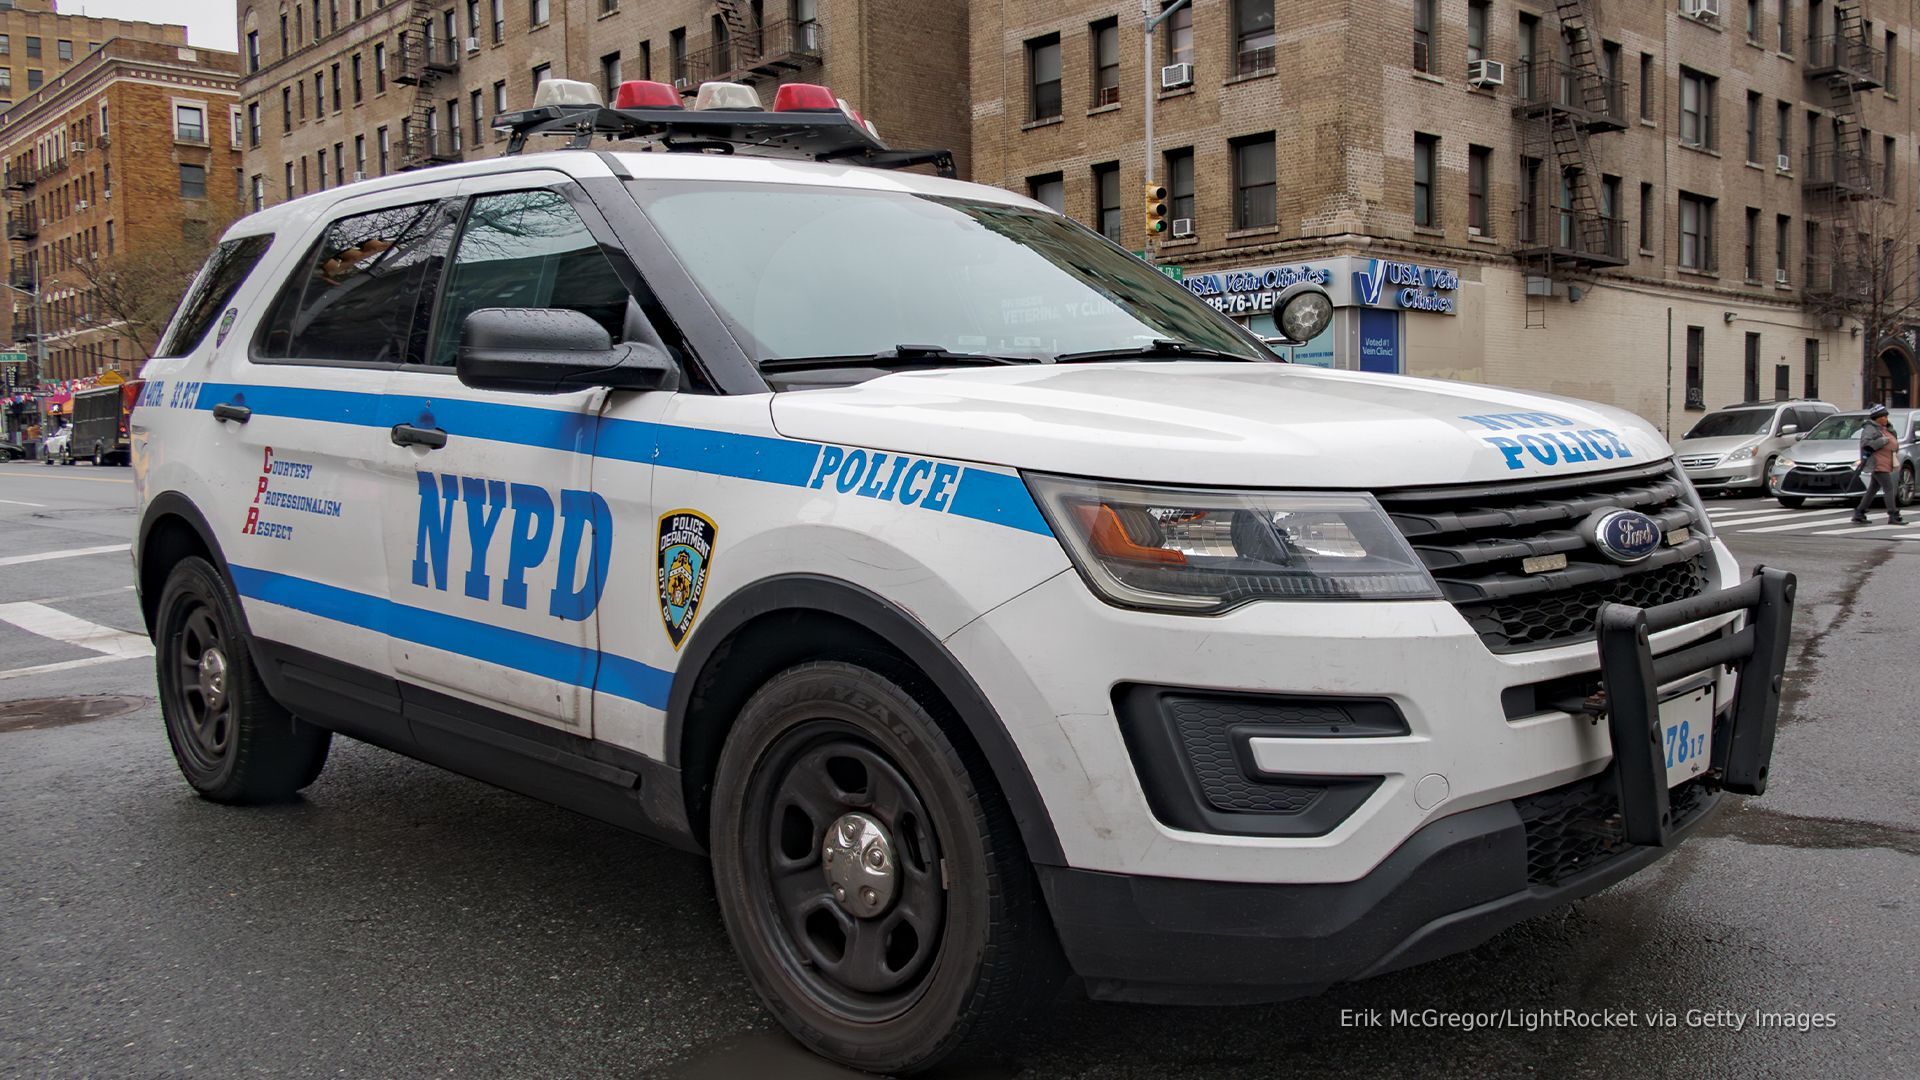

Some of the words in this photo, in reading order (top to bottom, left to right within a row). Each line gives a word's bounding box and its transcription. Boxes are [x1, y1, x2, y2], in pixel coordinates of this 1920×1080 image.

[1181, 275, 1219, 296] USA
[1225, 272, 1260, 293] Vein
[1262, 266, 1326, 290] Clinics
[1388, 262, 1425, 286] USA
[1430, 268, 1459, 290] Vein
[1400, 287, 1453, 312] Clinics
[1362, 346, 1376, 355] Vein
[1365, 337, 1382, 347] Voted
[170, 381, 184, 408] 33
[180, 381, 200, 409] PCT
[1457, 412, 1575, 431] NYPD
[263, 446, 313, 480] COURTESY
[1482, 428, 1633, 471] POLICE
[810, 445, 960, 513] POLICE
[253, 476, 342, 517] PROFESSIONALISM
[242, 507, 293, 541] RESPECT
[672, 516, 705, 537] POLICE
[1618, 519, 1653, 546] Ford
[411, 470, 613, 622] NYPD
[660, 530, 711, 560] DEPARTMENT
[658, 567, 667, 599] CITY
[692, 567, 706, 603] YORK
[662, 606, 672, 623] OF
[680, 606, 694, 634] NEW
